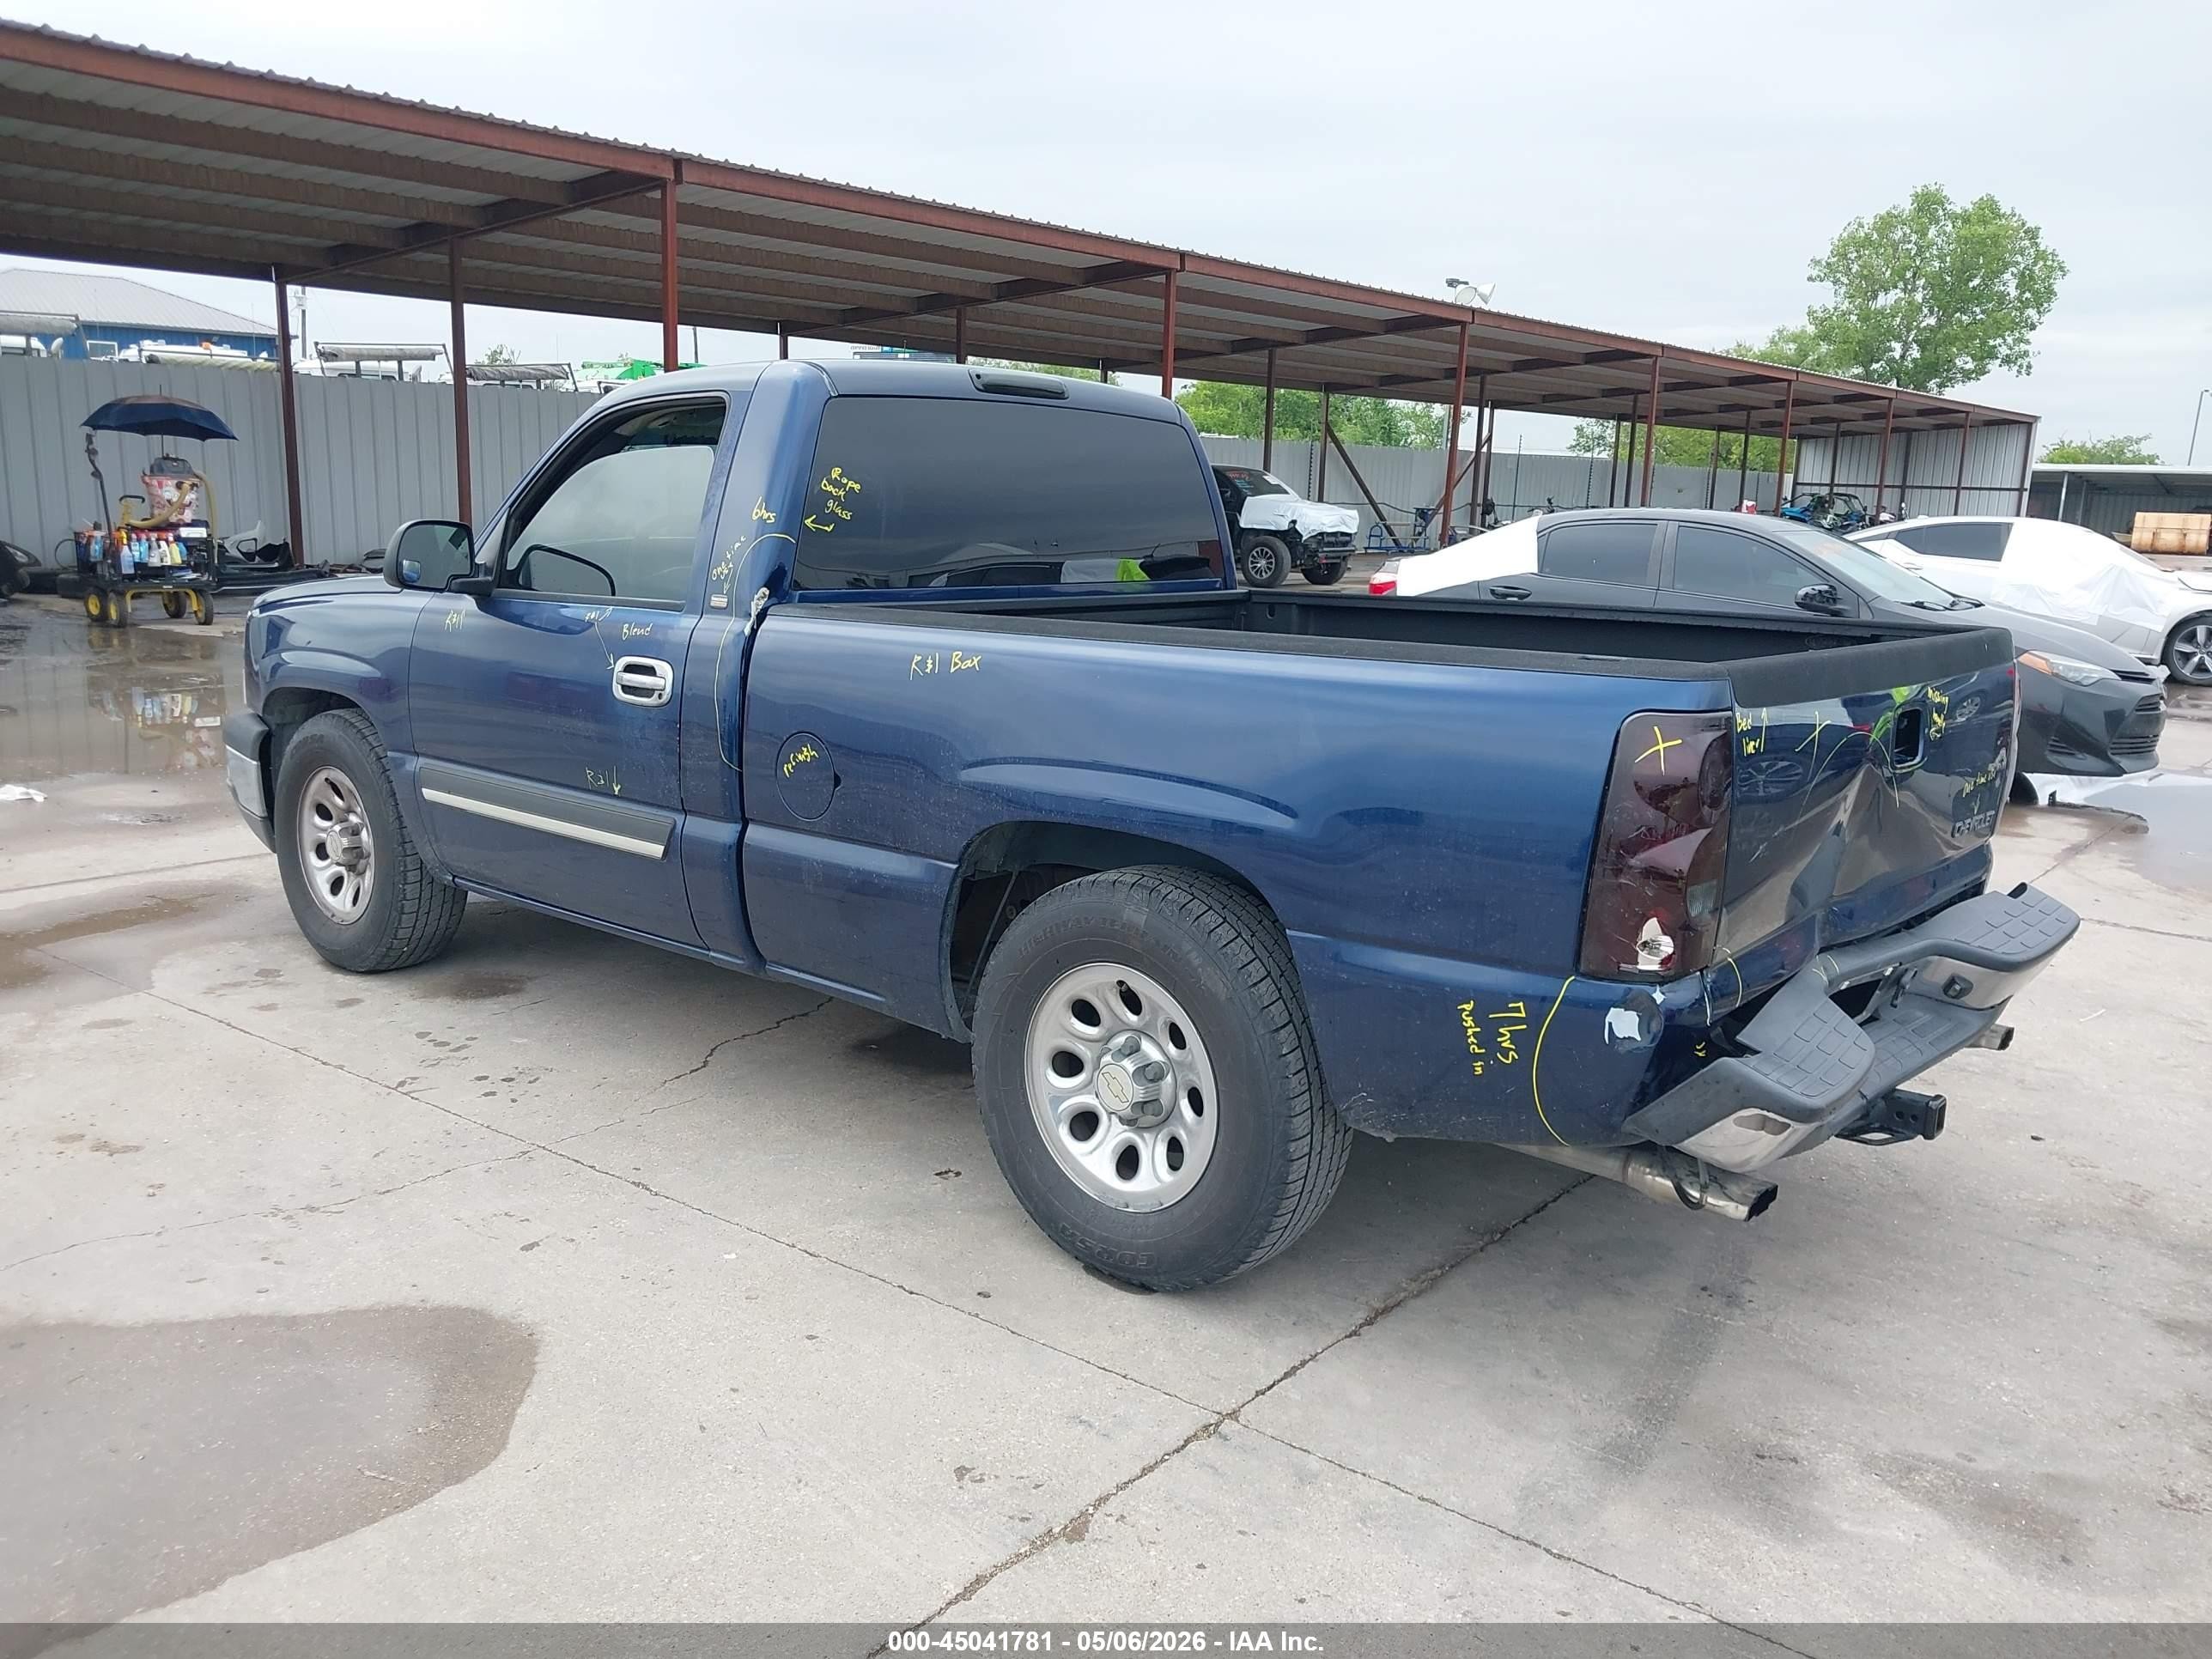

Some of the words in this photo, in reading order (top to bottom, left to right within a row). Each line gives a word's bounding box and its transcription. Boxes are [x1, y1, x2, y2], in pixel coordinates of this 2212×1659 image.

[751, 495, 776, 523] 6hrs
[825, 499, 853, 520] glass
[622, 622, 653, 641] Blend
[1457, 1000, 1486, 1054] pushed
[1472, 1061, 1484, 1076] in
